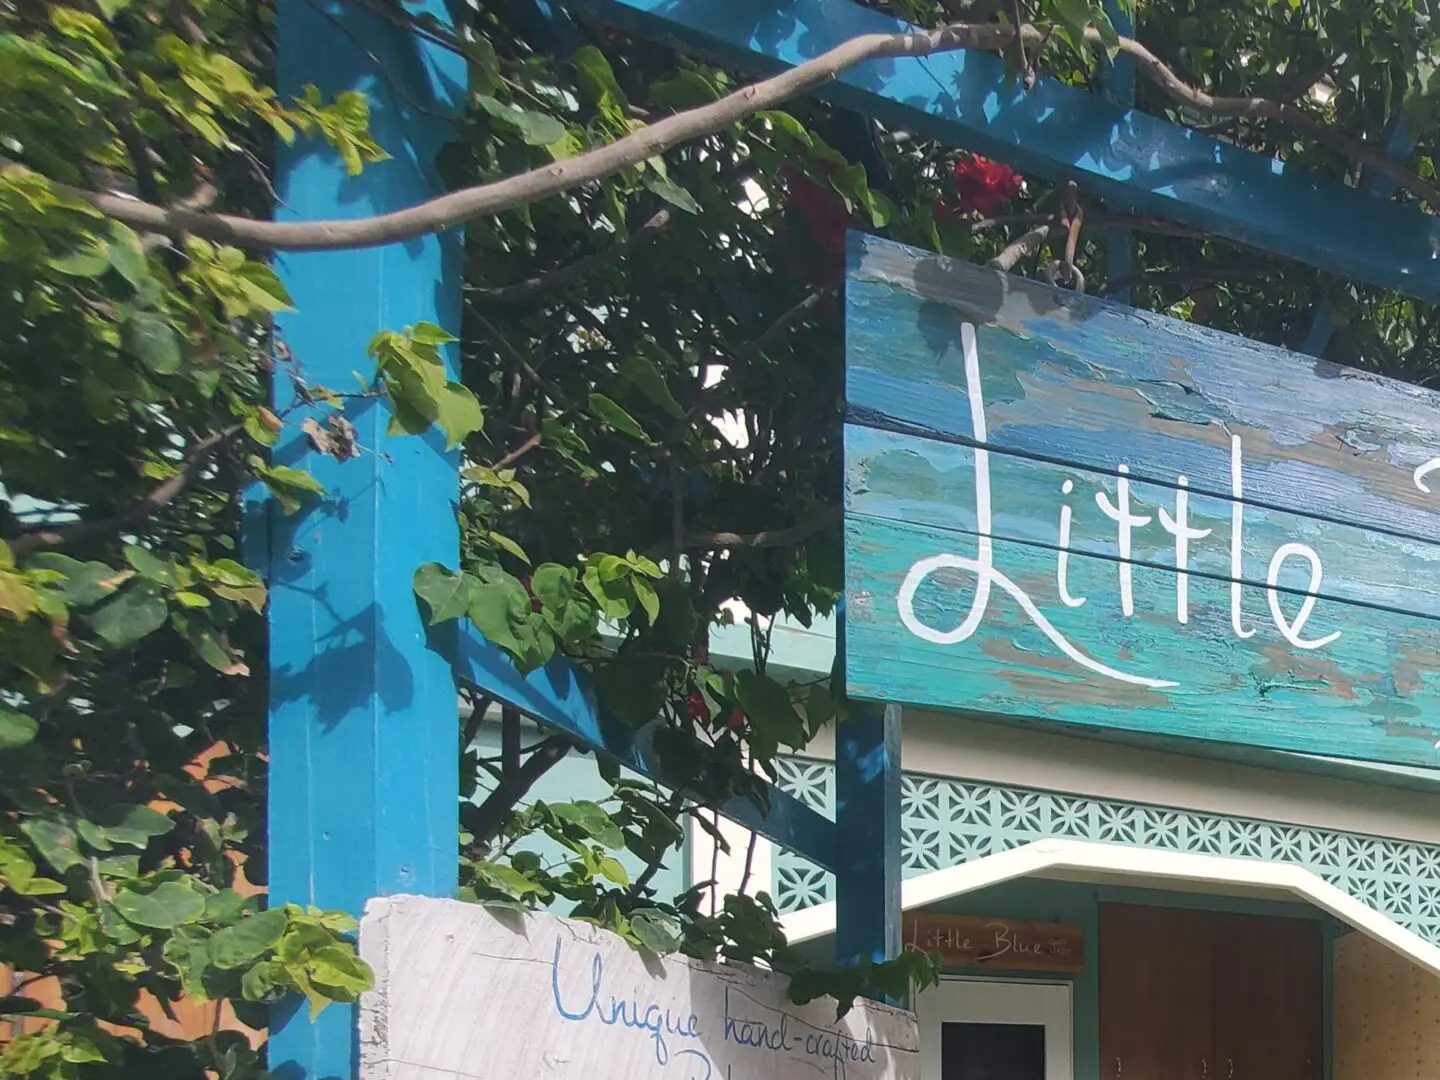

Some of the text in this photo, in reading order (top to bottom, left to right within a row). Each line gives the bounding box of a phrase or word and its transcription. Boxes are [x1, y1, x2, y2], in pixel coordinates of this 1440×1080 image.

[897, 322, 1341, 688] Little
[551, 933, 702, 1067] Unique
[904, 918, 973, 957] Little
[975, 922, 1041, 960] Blue
